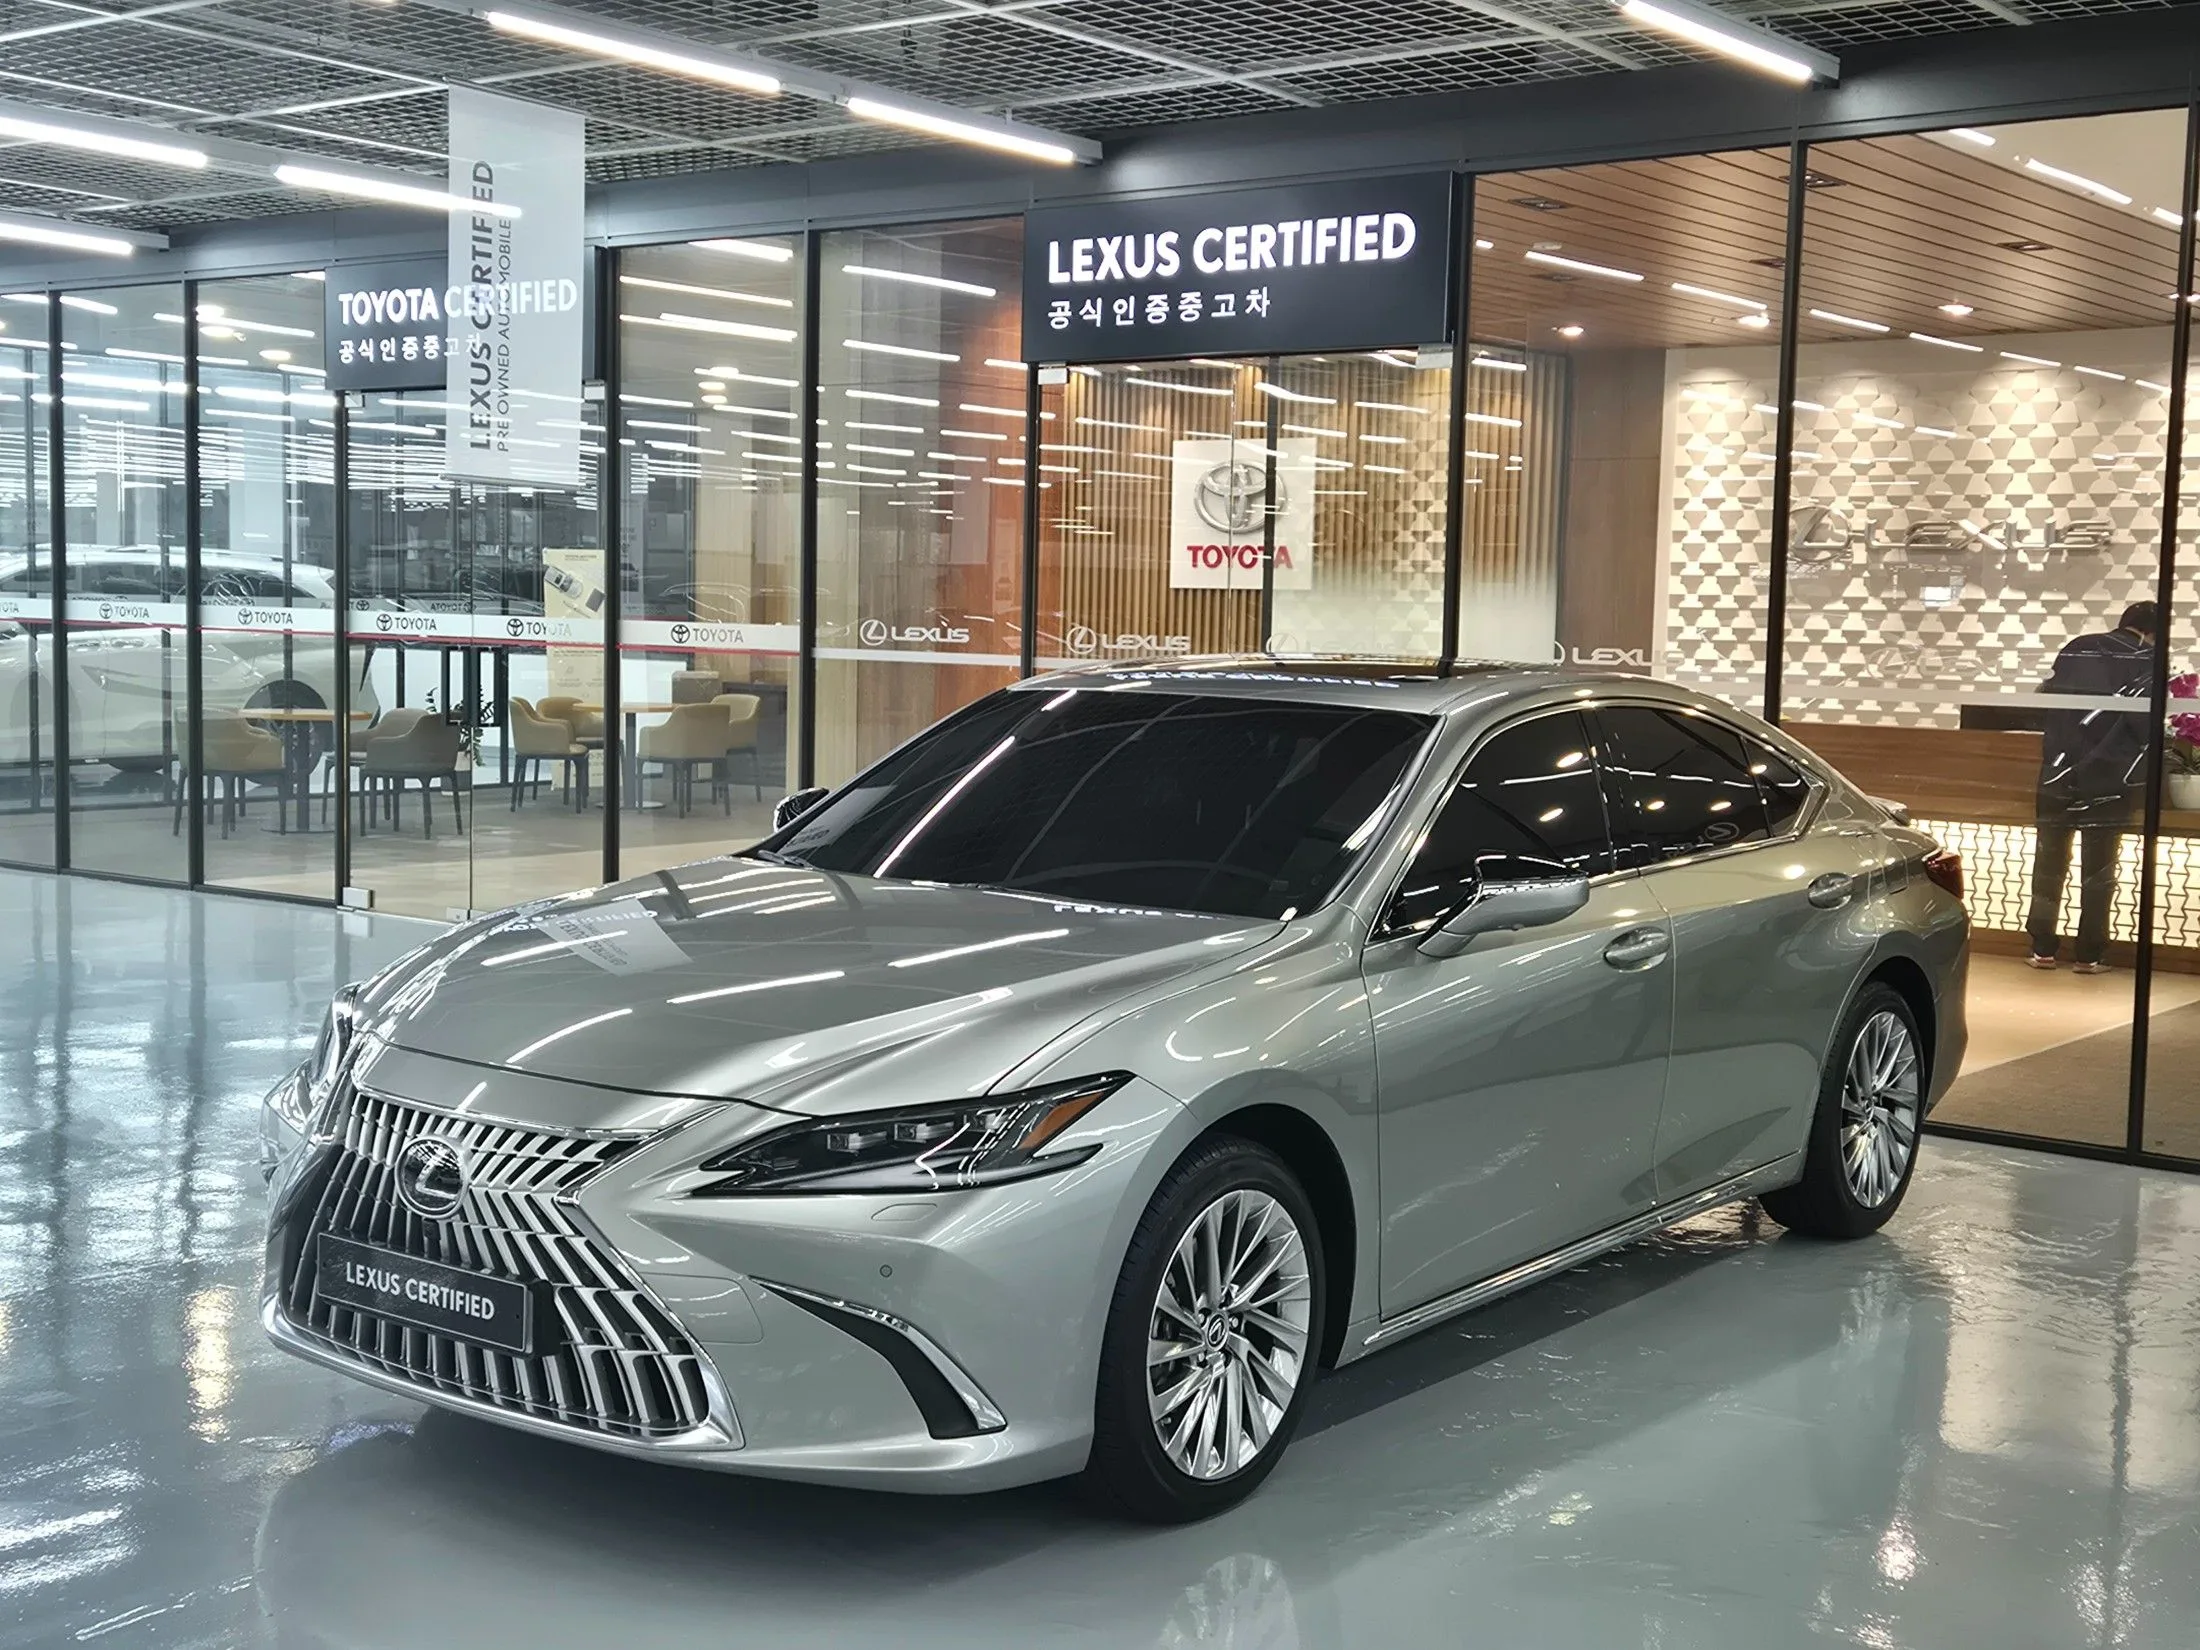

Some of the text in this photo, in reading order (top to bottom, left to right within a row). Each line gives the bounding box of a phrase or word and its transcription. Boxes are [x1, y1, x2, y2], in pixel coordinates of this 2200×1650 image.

[1048, 211, 1417, 284] LEXUS CERTIFIED
[338, 278, 578, 326] TOYOTA CERTIFIED
[470, 160, 493, 449] LEXUS CRTIFED
[1047, 286, 1272, 330] 공식인증중고차
[497, 344, 510, 415] OWNED
[1864, 517, 2113, 550] LEXUS
[114, 604, 150, 619] TOYOTA
[254, 610, 294, 625] TOYOTA
[394, 616, 437, 632] TOYOTA
[526, 620, 573, 637] TOYOTA
[692, 627, 744, 644] TOYOTA
[891, 626, 970, 644] LEXUS
[1102, 633, 1192, 652] LEXUS
[346, 1261, 496, 1321] LEXUS CERTIFIED
